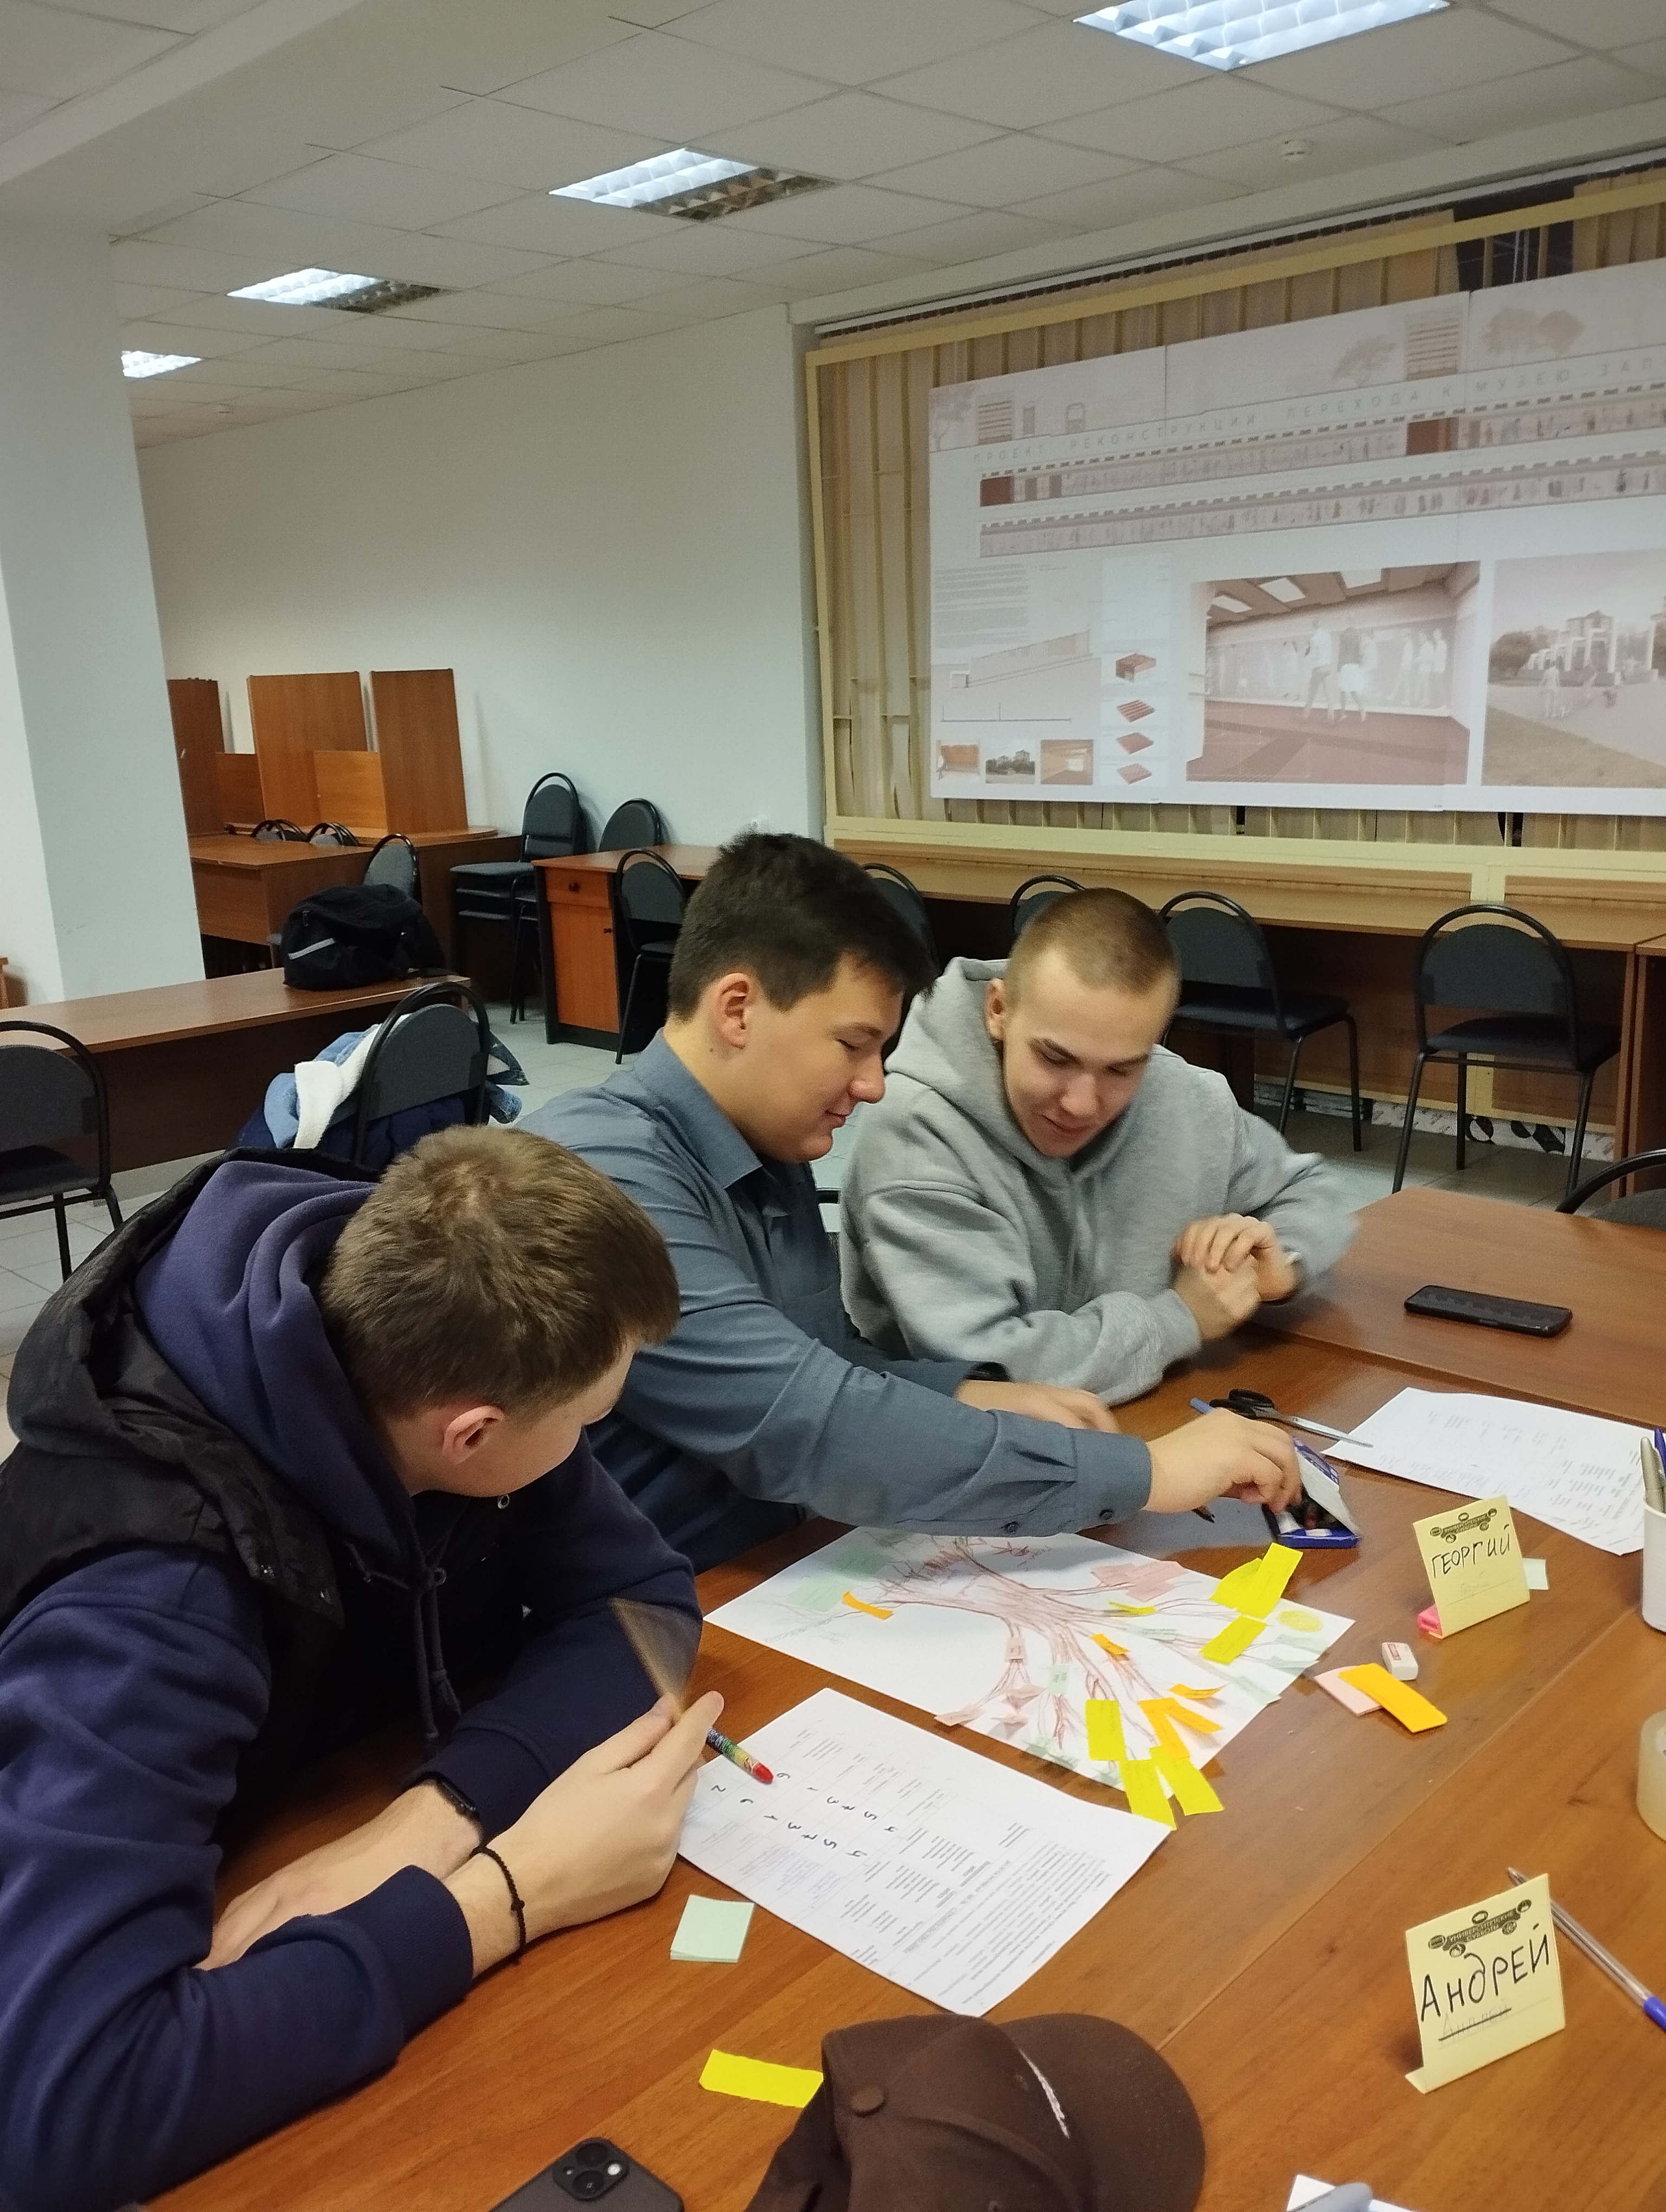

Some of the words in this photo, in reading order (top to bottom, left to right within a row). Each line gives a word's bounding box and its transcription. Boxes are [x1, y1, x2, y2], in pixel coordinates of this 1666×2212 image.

[973, 444, 1045, 464] ПРОЕКТ
[1070, 414, 1257, 451] РЕКОНСТРУКЦИИ
[1286, 390, 1418, 420] ПЕРЕХОДА
[1443, 384, 1452, 397] К
[1475, 357, 1653, 392] МУЗЕЮ-ЗАП
[1432, 1524, 1510, 1579] ГЕОРГИЙ
[710, 1784, 726, 1793] 2
[826, 1796, 840, 1804] 3
[864, 1811, 877, 1821] 5
[787, 1822, 802, 1830] 3
[823, 1838, 837, 1849] 5
